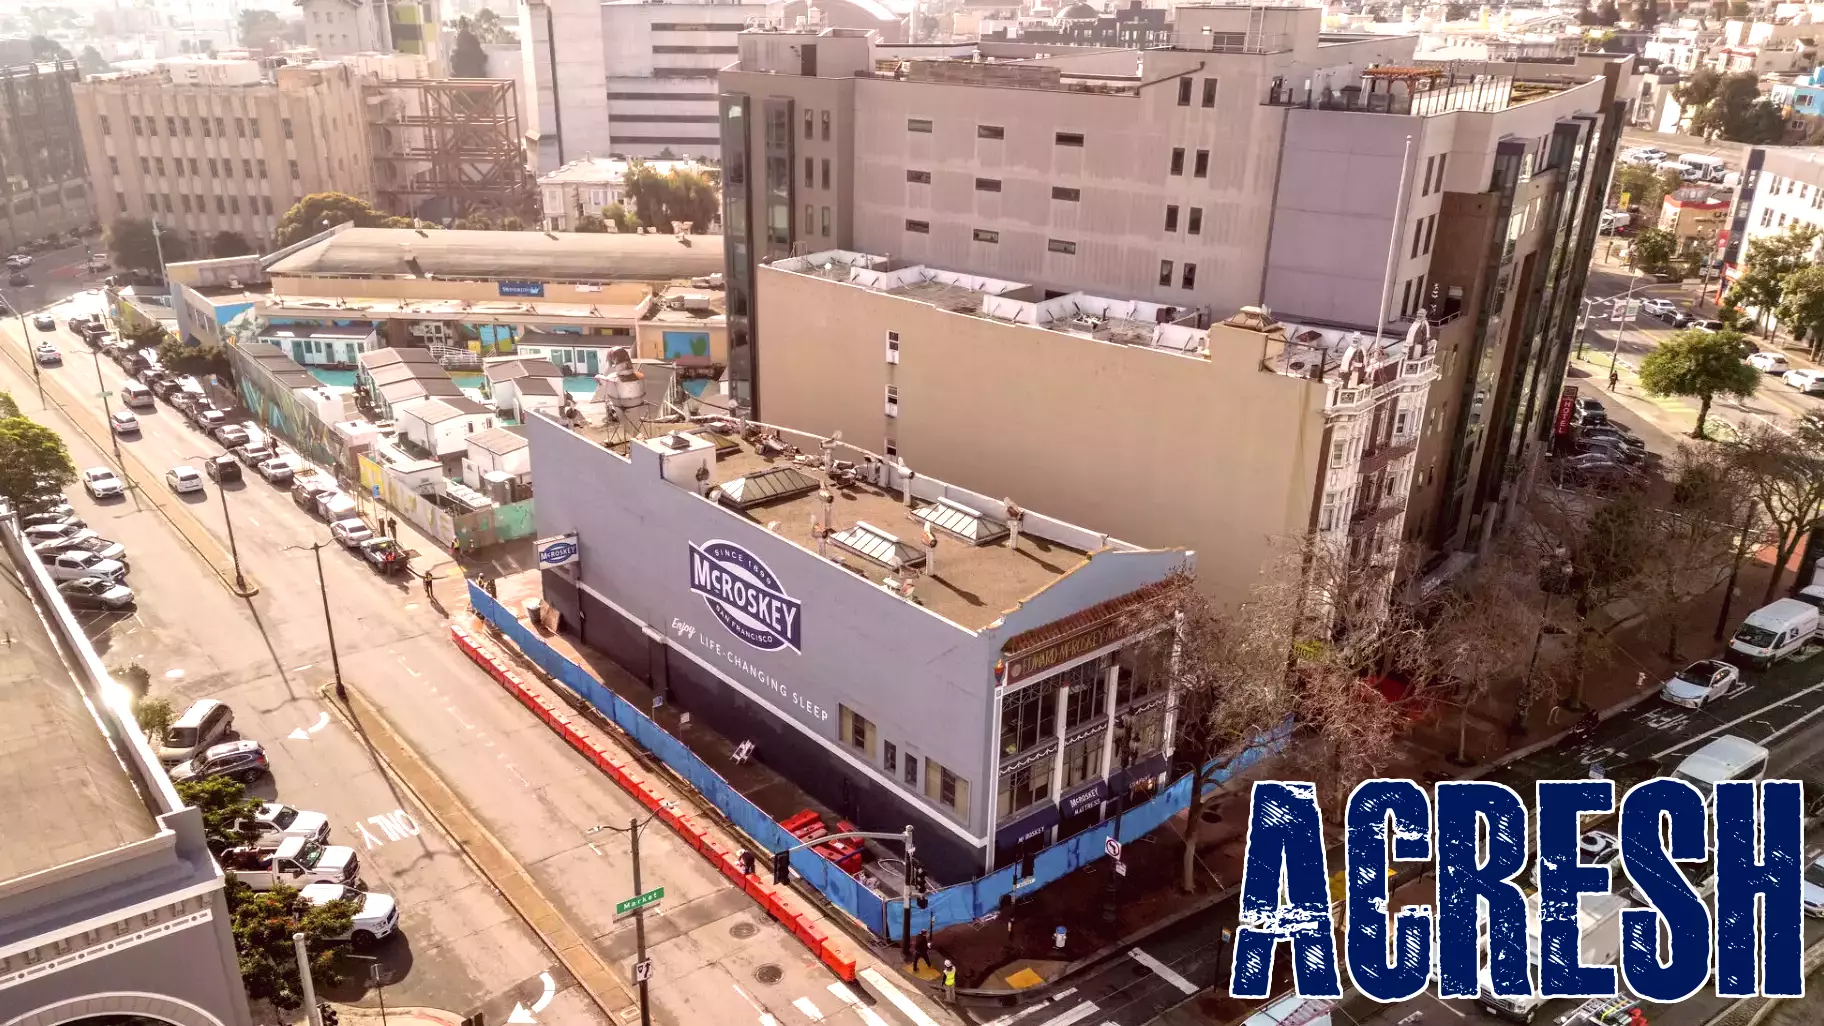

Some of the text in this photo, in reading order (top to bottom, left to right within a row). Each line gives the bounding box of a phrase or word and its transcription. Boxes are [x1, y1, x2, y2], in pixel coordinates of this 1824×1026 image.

[1558, 400, 1571, 434] HOTEL
[714, 549, 743, 562] SINCE
[693, 552, 797, 639] McROSKEY
[715, 604, 773, 643] SAN FRANCISCO
[671, 617, 829, 721] Enjoy LIFE-CHANGING SLEEP
[355, 809, 420, 849] ONLY
[623, 892, 657, 910] Market
